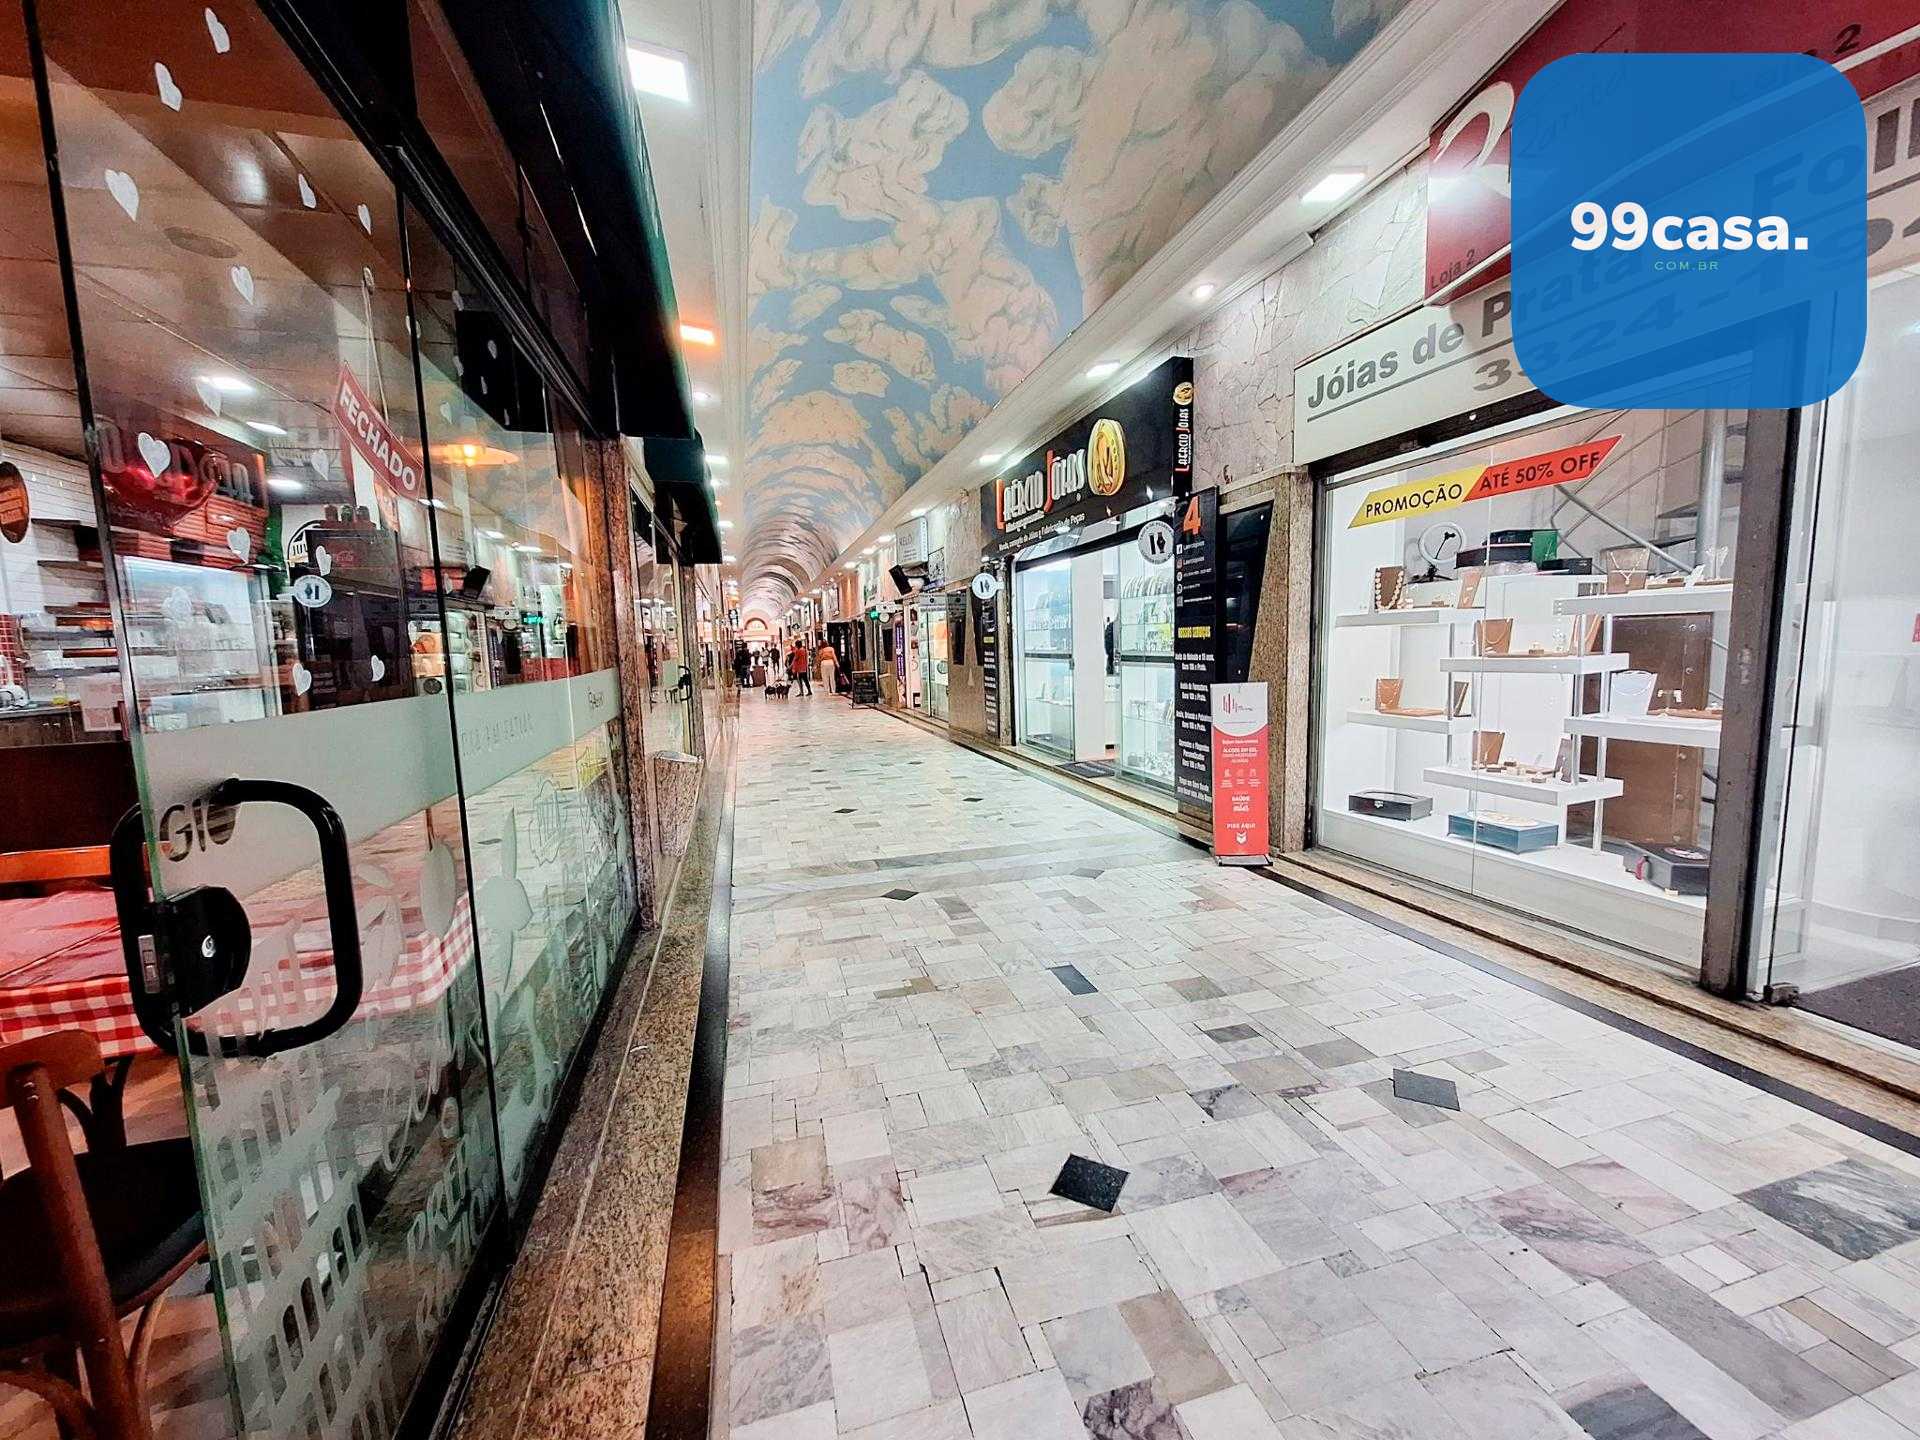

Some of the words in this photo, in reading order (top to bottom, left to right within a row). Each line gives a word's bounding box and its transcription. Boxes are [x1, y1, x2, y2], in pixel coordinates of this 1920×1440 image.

[1834, 23, 1862, 55] 2
[1431, 258, 1462, 289] Loja
[1466, 249, 1475, 266] 2
[1308, 350, 1398, 409] Jóias
[1413, 322, 1464, 365] de
[339, 381, 417, 491] FECHADO
[1365, 483, 1463, 518] PROMOÇÃO
[1479, 464, 1509, 491] ATÉ
[1515, 462, 1553, 485] 50%
[1561, 451, 1600, 474] OFF
[1183, 495, 1201, 535] 4
